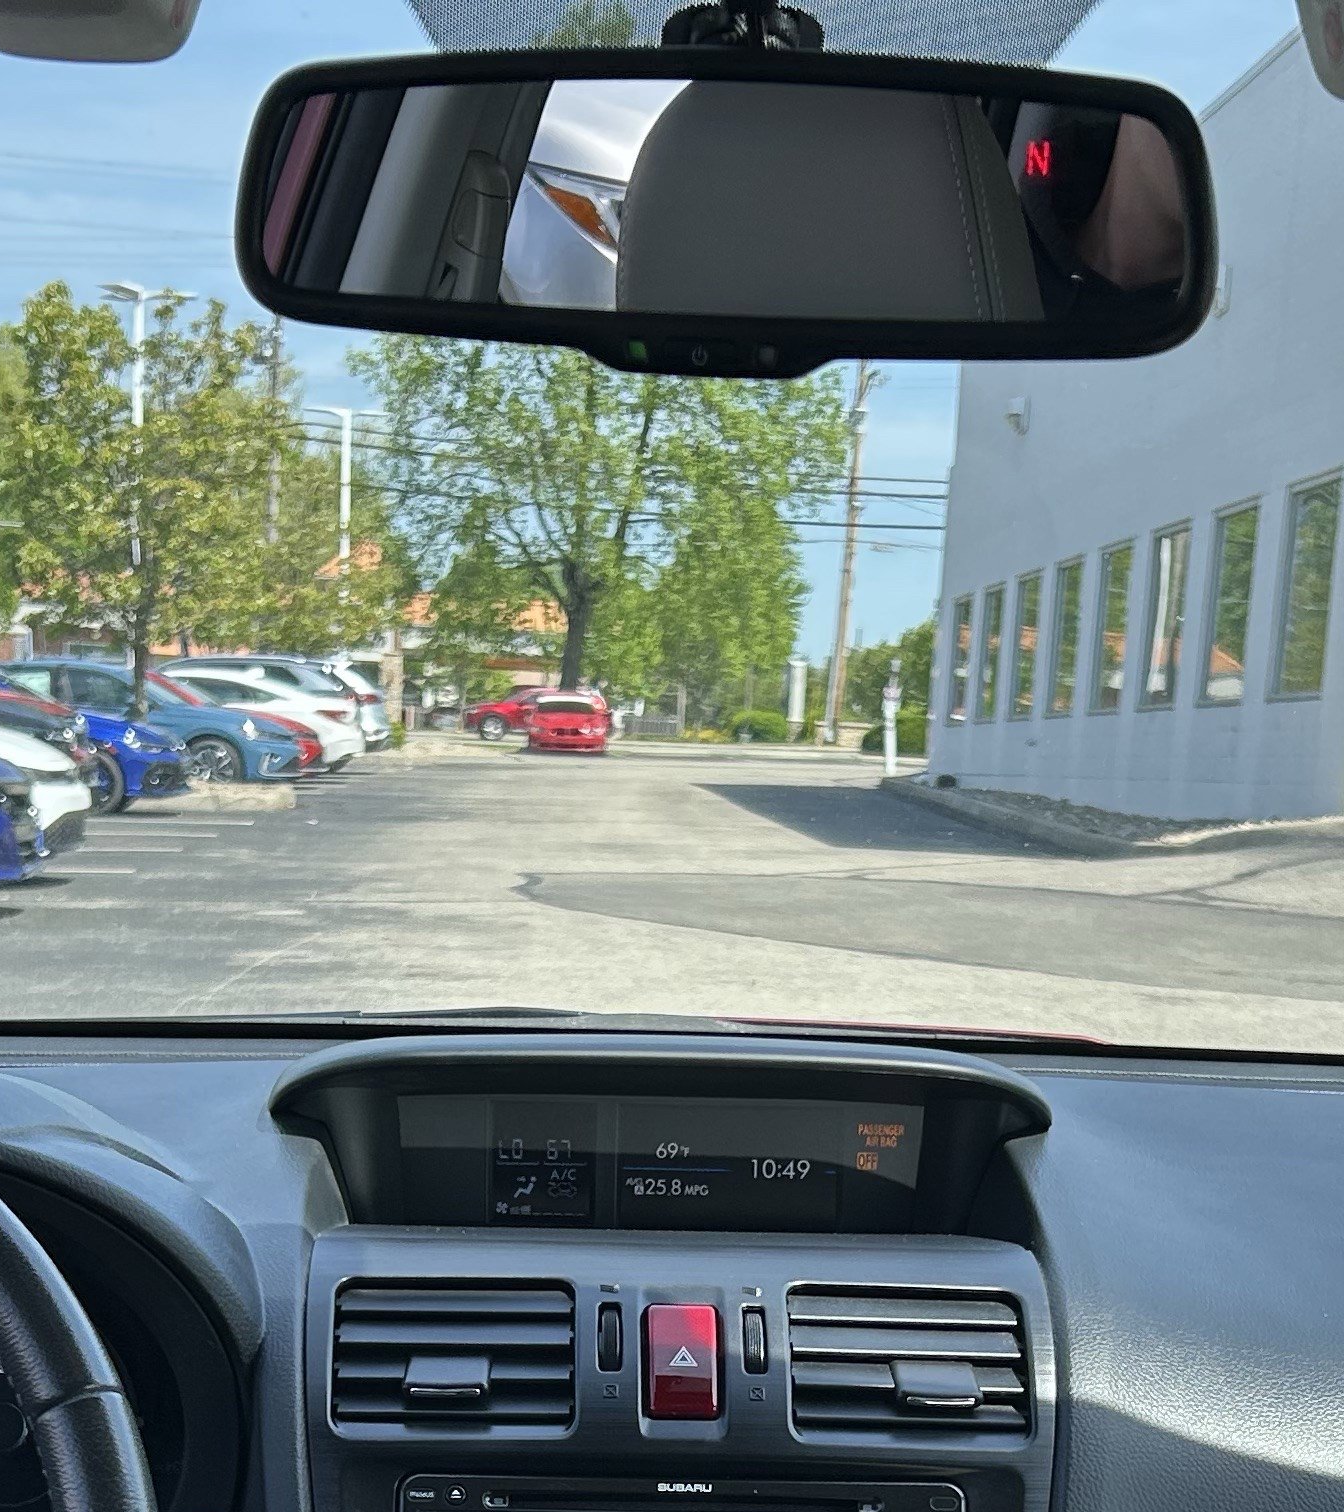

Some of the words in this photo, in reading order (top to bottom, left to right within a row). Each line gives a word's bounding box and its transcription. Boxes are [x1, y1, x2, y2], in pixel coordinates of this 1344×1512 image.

[1027, 140, 1050, 175] N
[858, 1153, 877, 1169] OFF
[550, 1168, 577, 1180] A/C
[751, 1159, 811, 1180] 10:49
[645, 1179, 682, 1196] 25.8
[684, 1184, 709, 1196] MPG
[657, 1482, 713, 1493] SUBARU
